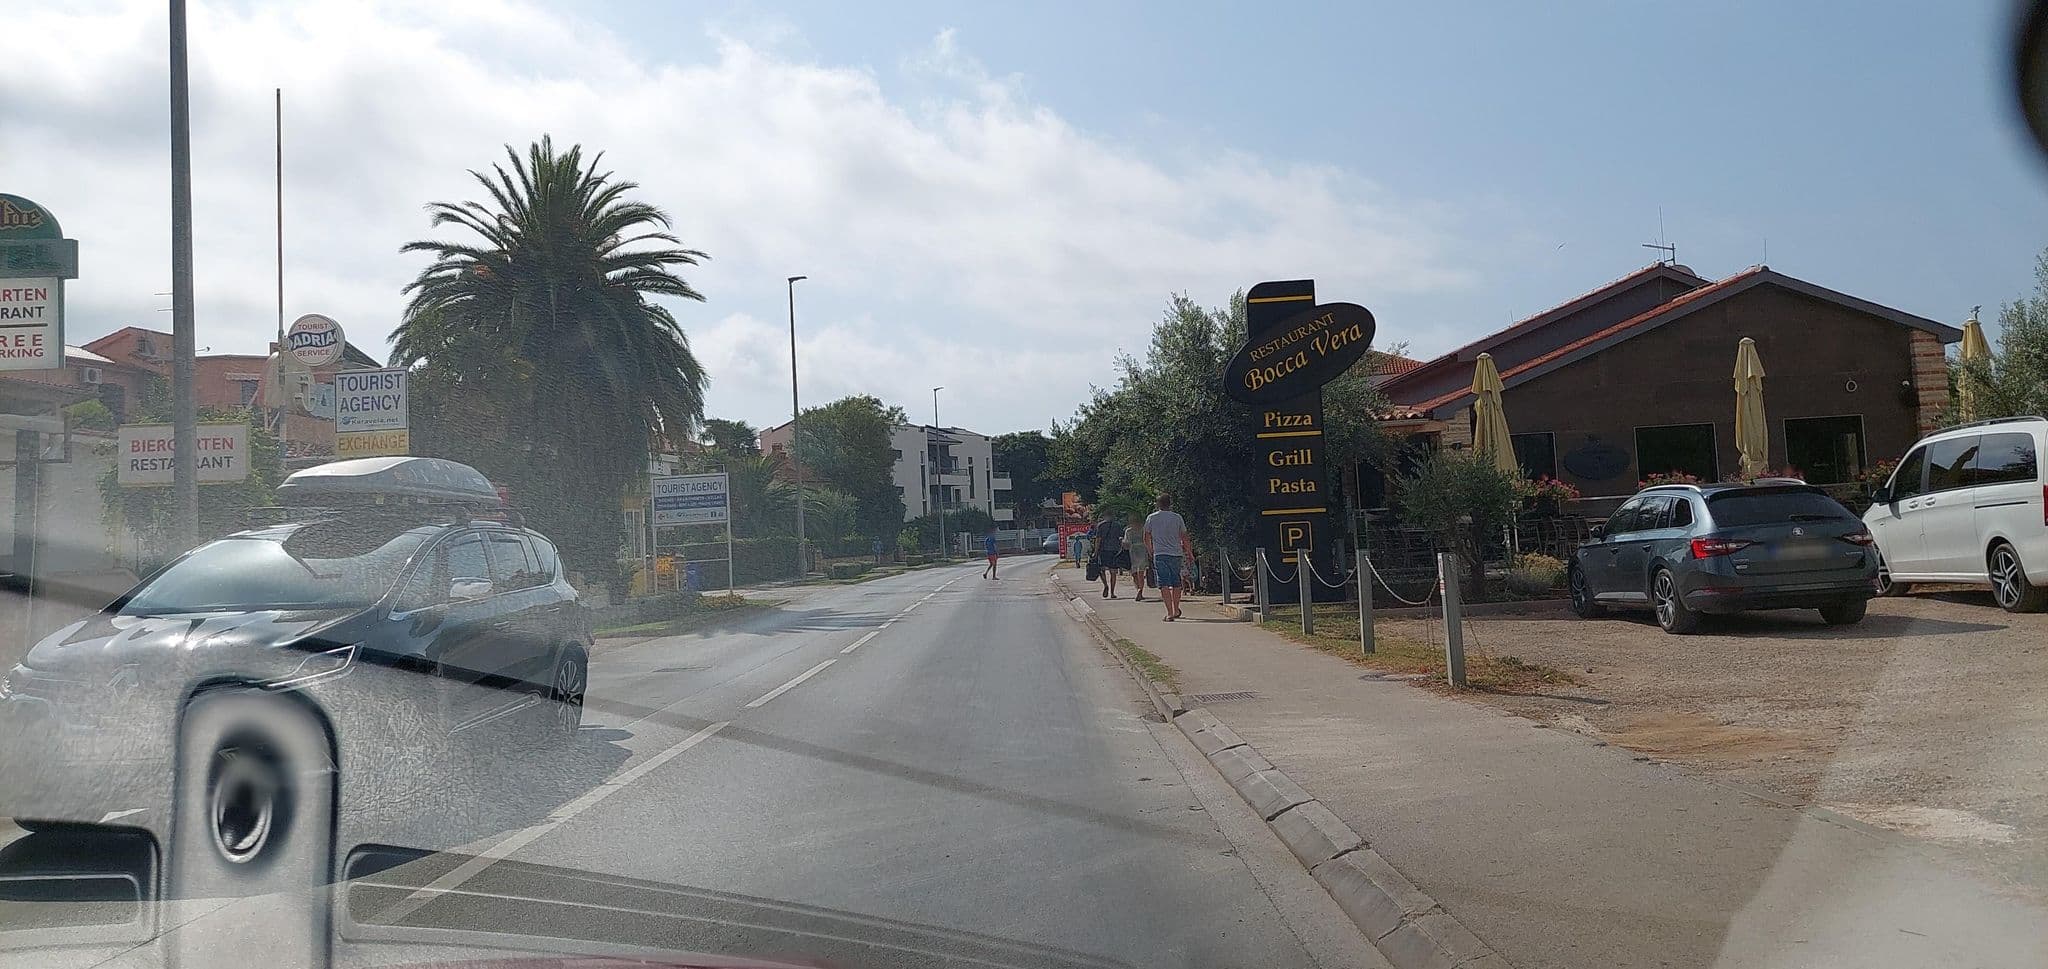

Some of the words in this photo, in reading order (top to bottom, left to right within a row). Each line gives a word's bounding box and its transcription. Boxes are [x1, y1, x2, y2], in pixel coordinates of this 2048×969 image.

[0, 288, 47, 302] RTEN
[0, 306, 45, 319] RANT
[297, 323, 328, 331] TOURIST
[0, 334, 43, 348] REE
[294, 331, 335, 348] ADRIA
[1250, 312, 1335, 362] RESTAURANT
[297, 349, 330, 357] SERVICE
[1244, 350, 1308, 391] Bocca
[1310, 323, 1364, 357] Vera
[338, 374, 403, 392] TOURIST
[340, 394, 401, 413] AGENCY
[1263, 411, 1313, 428] Pizza
[338, 433, 406, 451] EXCHANGE
[130, 456, 234, 471] RESTAANT
[1268, 448, 1313, 467] Grill
[657, 483, 690, 493] TOURIST
[691, 482, 723, 491] AGENCY
[1269, 478, 1317, 494] Pasta
[1288, 528, 1304, 547] P
